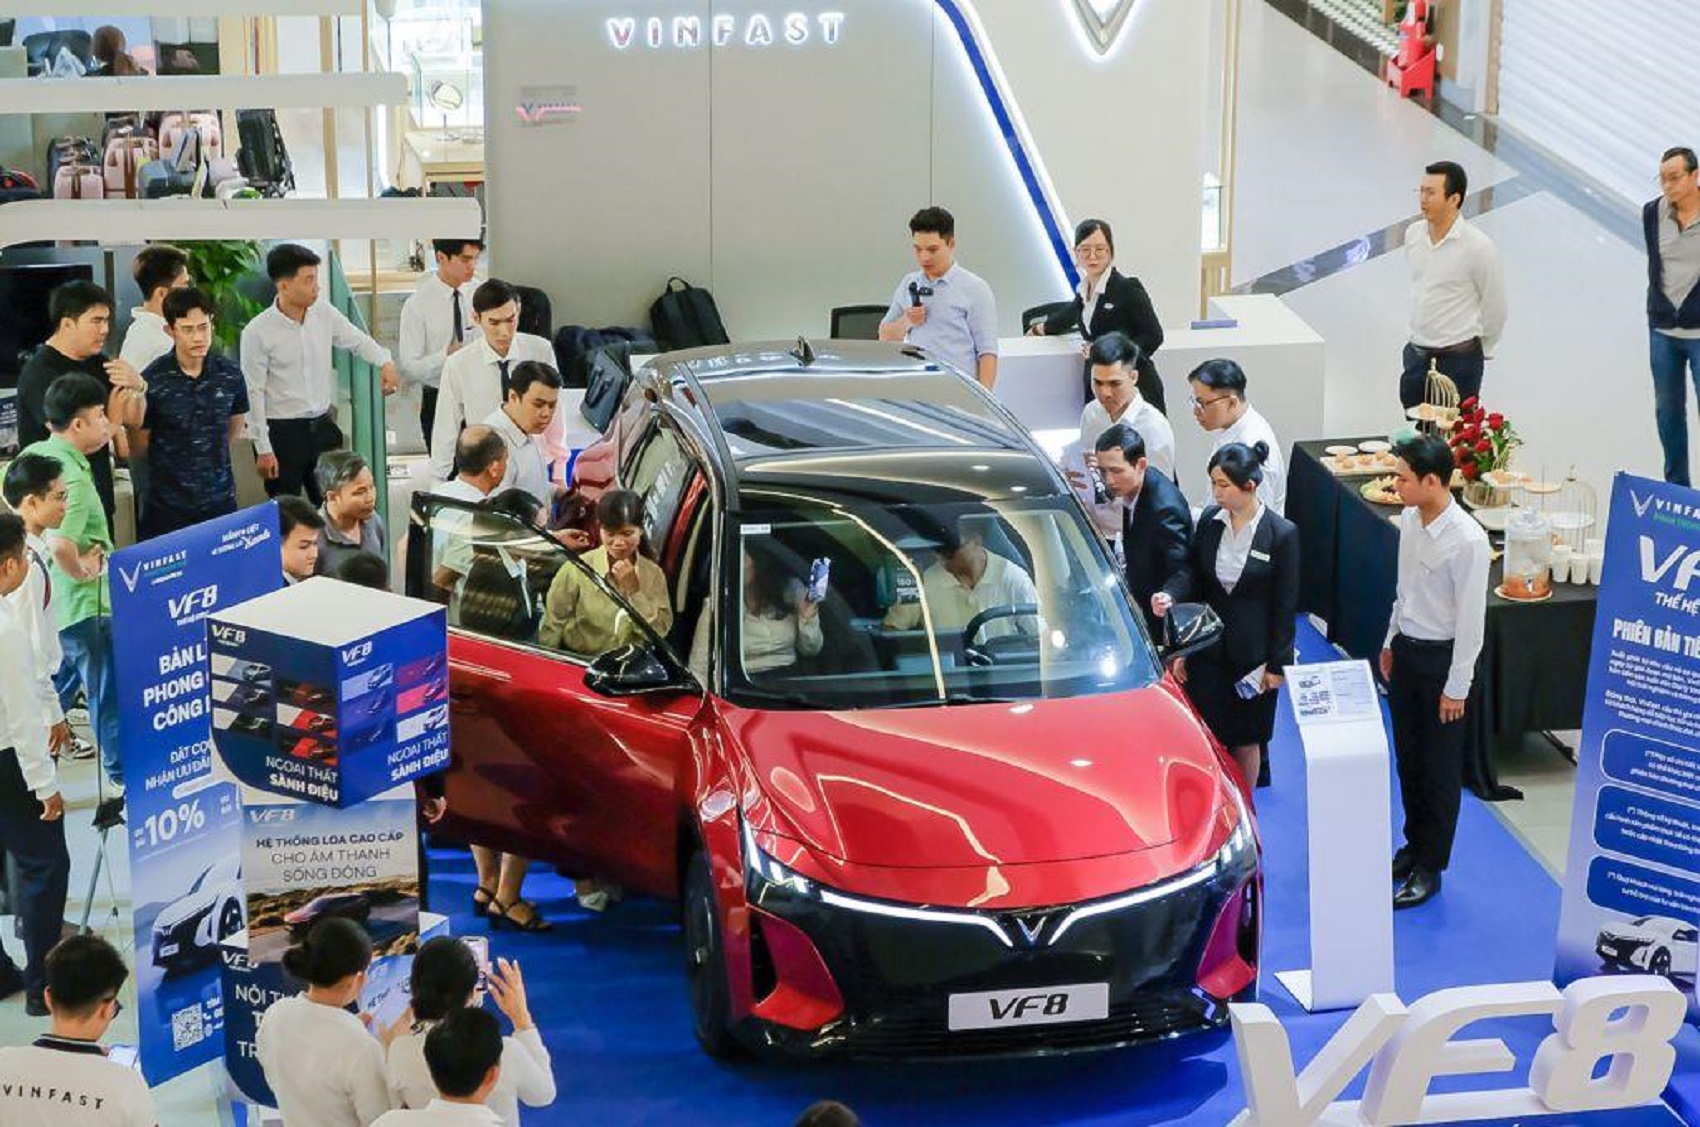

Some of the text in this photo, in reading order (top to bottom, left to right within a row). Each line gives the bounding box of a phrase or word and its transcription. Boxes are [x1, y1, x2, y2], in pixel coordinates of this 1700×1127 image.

[606, 12, 845, 49] VINFAST
[168, 584, 219, 620] VF8
[1655, 591, 1683, 610] THẾ
[211, 624, 246, 644] VF8
[1613, 618, 1651, 646] PHIÊN
[1653, 624, 1681, 654] BẢN
[159, 645, 195, 676] BẢN
[341, 640, 373, 664] VF8
[143, 671, 205, 709] PHONG
[153, 698, 203, 731] CÔNG
[391, 747, 449, 782] SÀNH ĐIỆU
[269, 773, 339, 802] SÀNH ĐIỆU
[250, 808, 295, 823] VF8
[256, 831, 404, 850] HỆ THỐNG LOA CAO CẤP
[271, 851, 307, 865] CHO
[338, 848, 391, 862] THANH
[283, 865, 328, 882] SỐNG
[235, 983, 266, 1006] NỘI
[989, 993, 1069, 1021] VF8
[1230, 974, 1688, 1127] VF8
[2, 1084, 105, 1110] VINFAST
